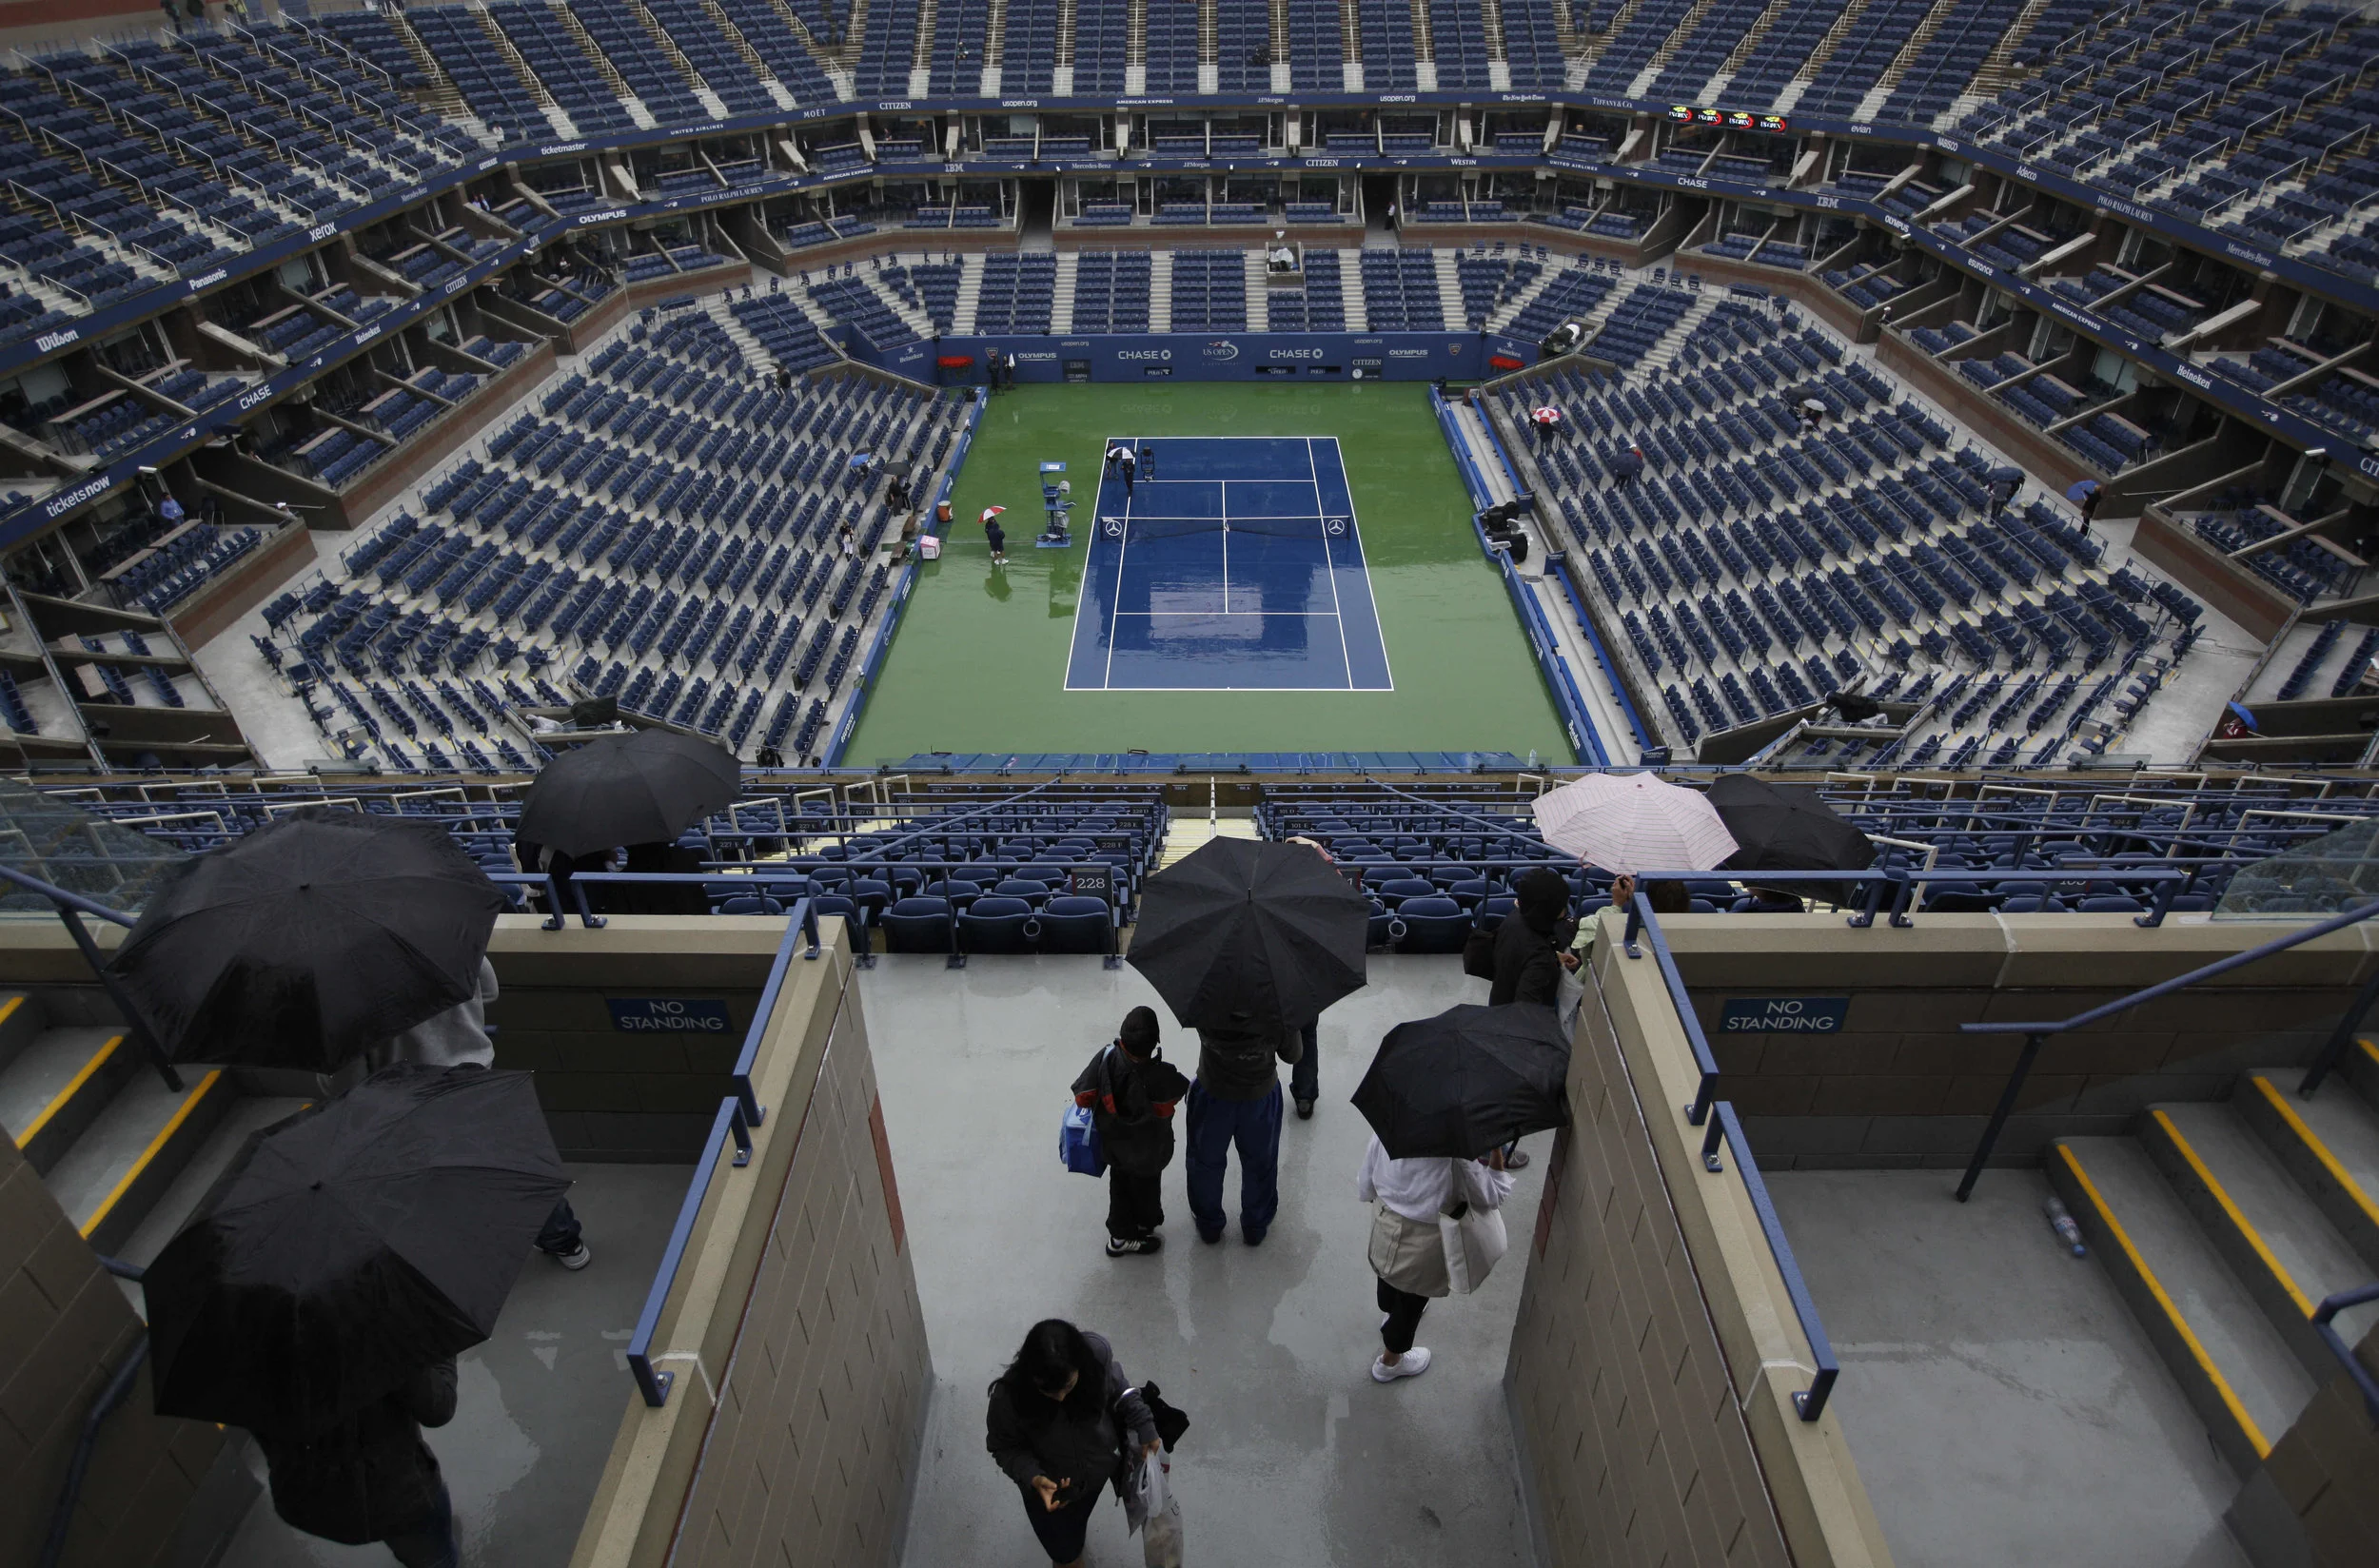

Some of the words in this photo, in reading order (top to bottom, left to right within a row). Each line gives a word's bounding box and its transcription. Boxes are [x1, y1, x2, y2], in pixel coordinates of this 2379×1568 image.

[879, 102, 912, 110] CITIZEN
[670, 127, 694, 136] UNITED
[696, 124, 724, 132] AIRLINES
[1851, 125, 1872, 134] evian
[1937, 136, 1958, 152] NABISCO
[945, 164, 964, 172] IBM
[2015, 166, 2037, 181] Adecco
[1678, 177, 1708, 188] CHASE
[700, 194, 718, 204] POLO
[718, 190, 738, 201] RALPH
[739, 186, 763, 198] LAUREN
[1816, 196, 1839, 209] IBM
[579, 209, 627, 225] OLYMPUS
[2096, 195, 2112, 208] POLO
[2112, 200, 2131, 216] RALPH
[2131, 206, 2154, 223] LAUREN
[1884, 214, 1910, 233] OLYMPUS
[308, 222, 337, 243] xerox
[2225, 243, 2271, 267] Mercedes-Benz
[1967, 258, 1994, 277] esurance
[188, 268, 227, 290] Panasonic
[444, 275, 468, 294] CITIZEN
[2052, 303, 2077, 320] AMERICAN
[2077, 315, 2101, 331] EXPRESS
[35, 329, 79, 352] Wilson
[355, 323, 382, 344] Heineken
[1118, 350, 1159, 360] CHASE
[1269, 349, 1310, 359] CHASE
[1497, 346, 1522, 358] Heineken
[2176, 364, 2211, 390] Heineken
[240, 385, 272, 410] CHASE
[46, 476, 110, 518] ticketsnow
[1076, 877, 1105, 889] 228
[649, 1001, 684, 1014] NO
[1766, 1000, 1803, 1014] NO
[620, 1016, 723, 1030] STANDING
[1726, 1016, 1835, 1030] STANDING
